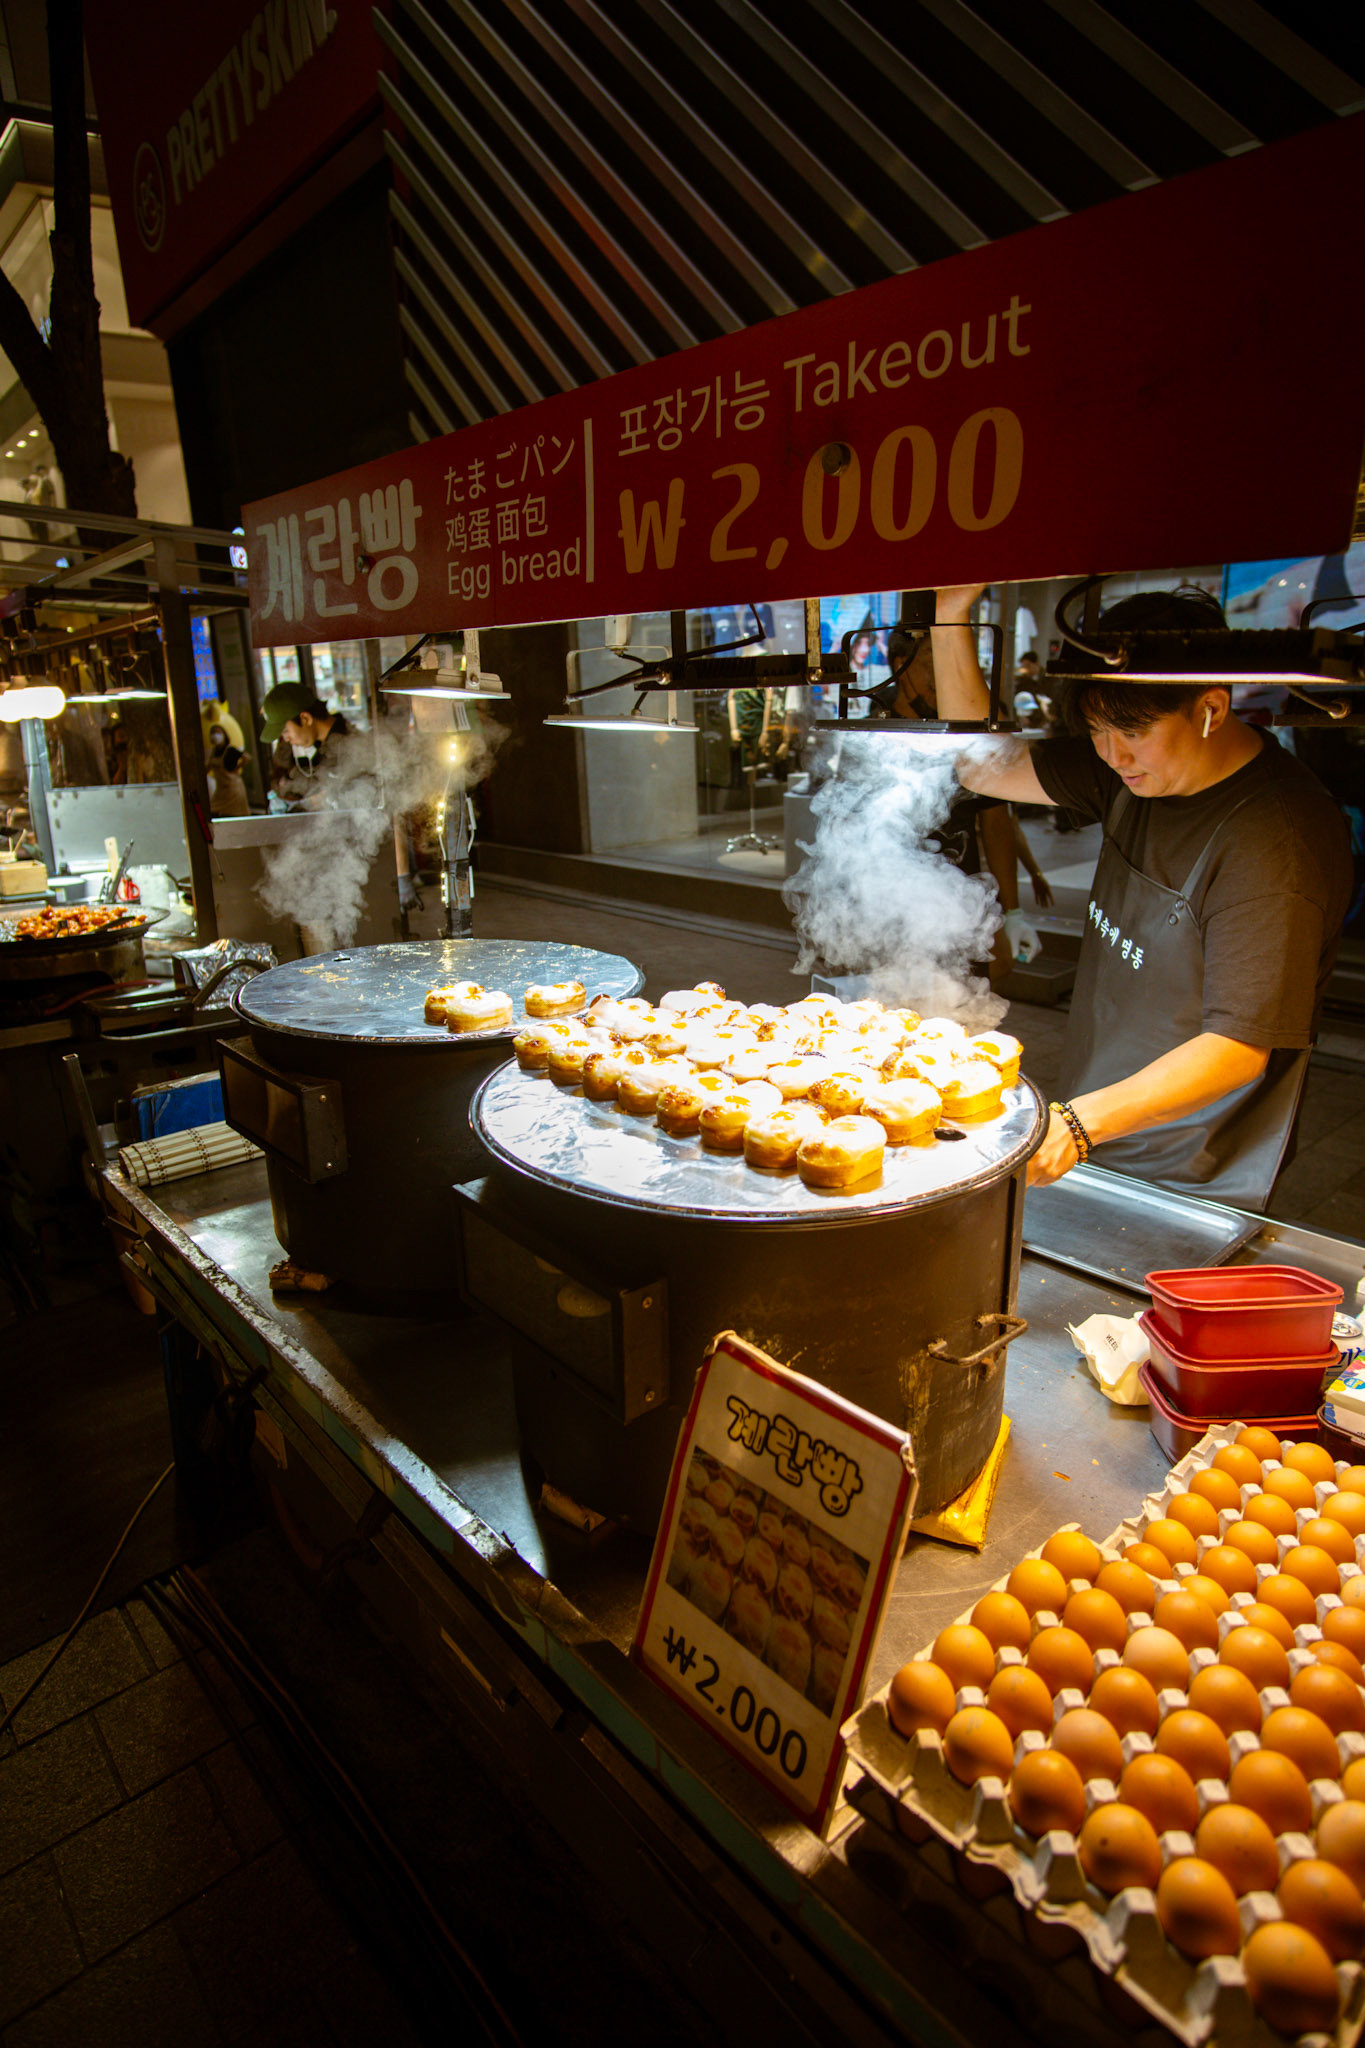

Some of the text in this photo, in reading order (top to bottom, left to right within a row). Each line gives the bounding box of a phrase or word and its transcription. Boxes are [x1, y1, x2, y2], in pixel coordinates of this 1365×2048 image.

[618, 295, 1033, 456] 포장가능 Takeout
[444, 434, 576, 505] たまごパン
[255, 478, 423, 622] 계란빵
[446, 493, 549, 553] 鸡蛋面包
[447, 537, 581, 601] Egg bread
[727, 1395, 863, 1517] 계란빵
